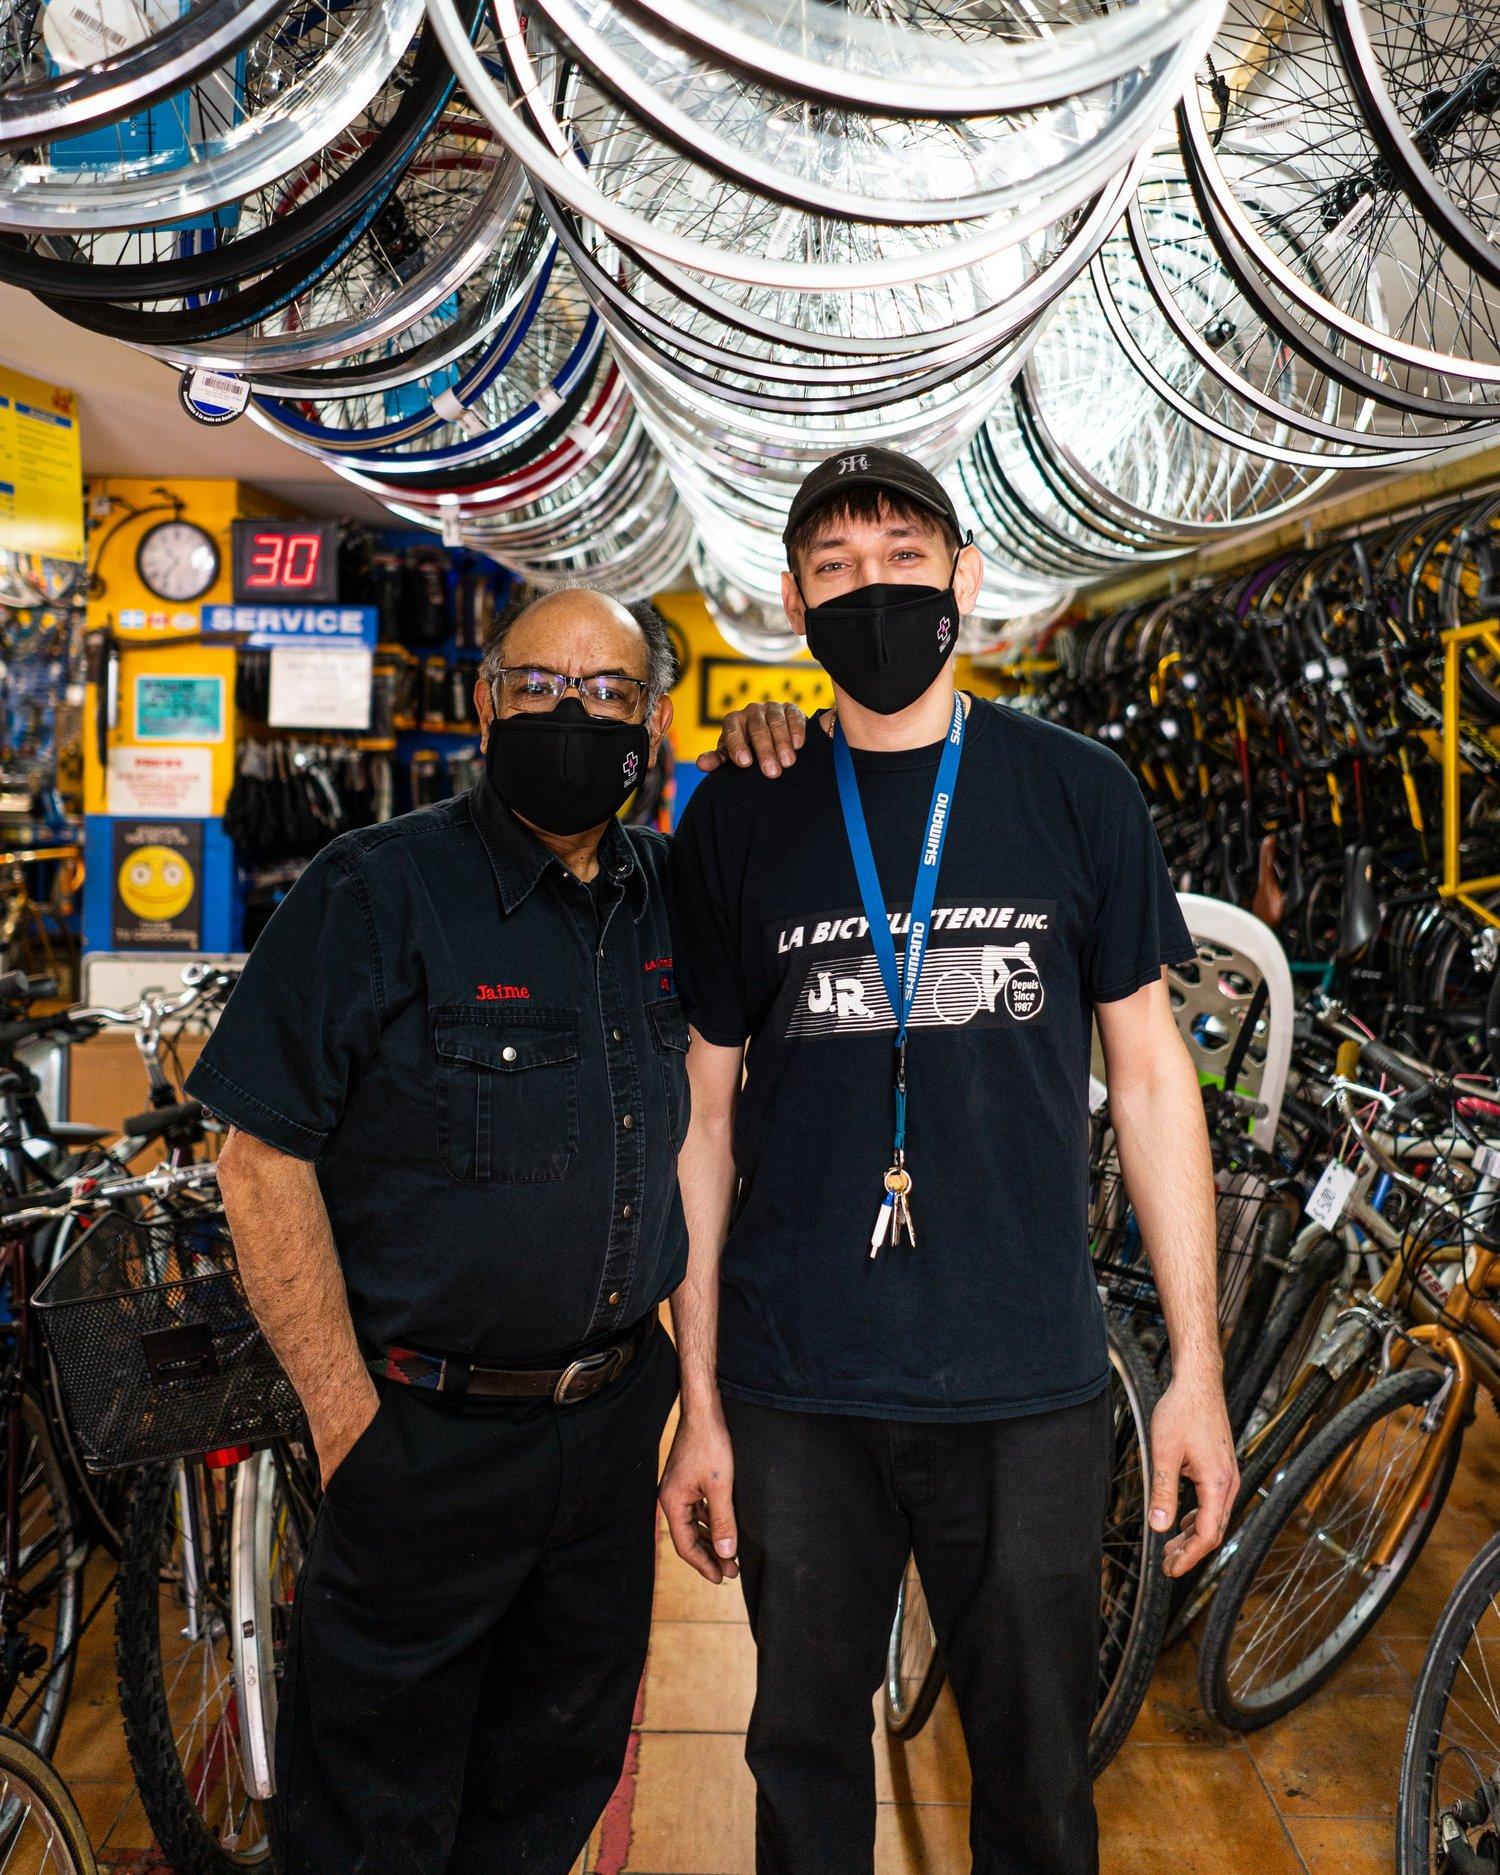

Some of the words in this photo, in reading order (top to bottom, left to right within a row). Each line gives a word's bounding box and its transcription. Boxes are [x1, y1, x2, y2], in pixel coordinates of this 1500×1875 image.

[246, 534, 321, 588] 30
[210, 607, 365, 635] SERVICE
[923, 792, 949, 866] SHIMANO
[778, 926, 804, 954] LA
[1014, 913, 1048, 930] INC.
[904, 921, 926, 1001] SHIMANO
[475, 983, 531, 1001] Jaime
[1011, 979, 1039, 991] Depuis
[1013, 992, 1035, 1001] Since
[1014, 1002, 1033, 1013] 1987
